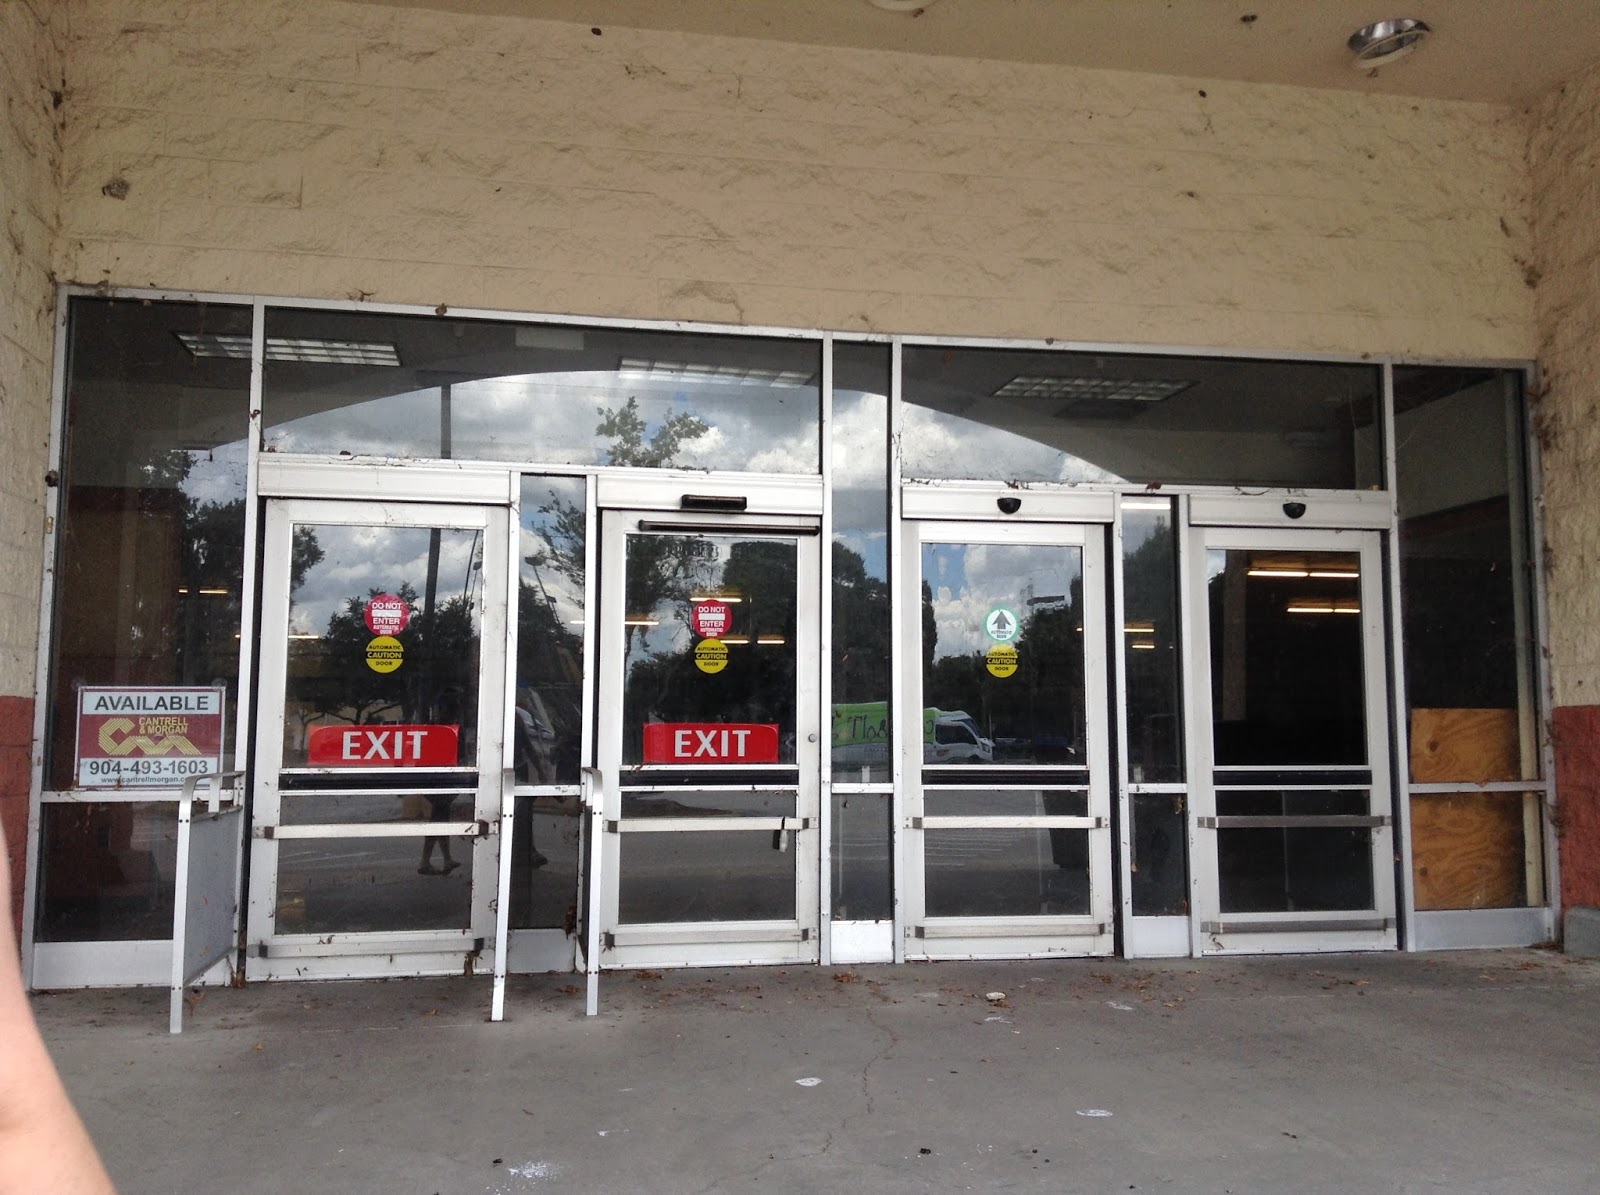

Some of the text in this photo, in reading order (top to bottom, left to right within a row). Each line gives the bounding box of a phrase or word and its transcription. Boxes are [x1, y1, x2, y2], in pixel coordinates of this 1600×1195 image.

[371, 602, 402, 610] DO NOT
[372, 617, 400, 625] ENTER
[699, 620, 725, 628] ENTER
[367, 651, 402, 659] CAUTION
[986, 657, 1017, 665] CAUTION
[94, 695, 209, 711] AVAILABLE
[138, 716, 189, 726] CANTRELL
[138, 725, 188, 735] & MORGAN
[342, 731, 428, 760] EXIT
[674, 729, 751, 758] EXIT
[89, 760, 209, 776] 904-493-1603
